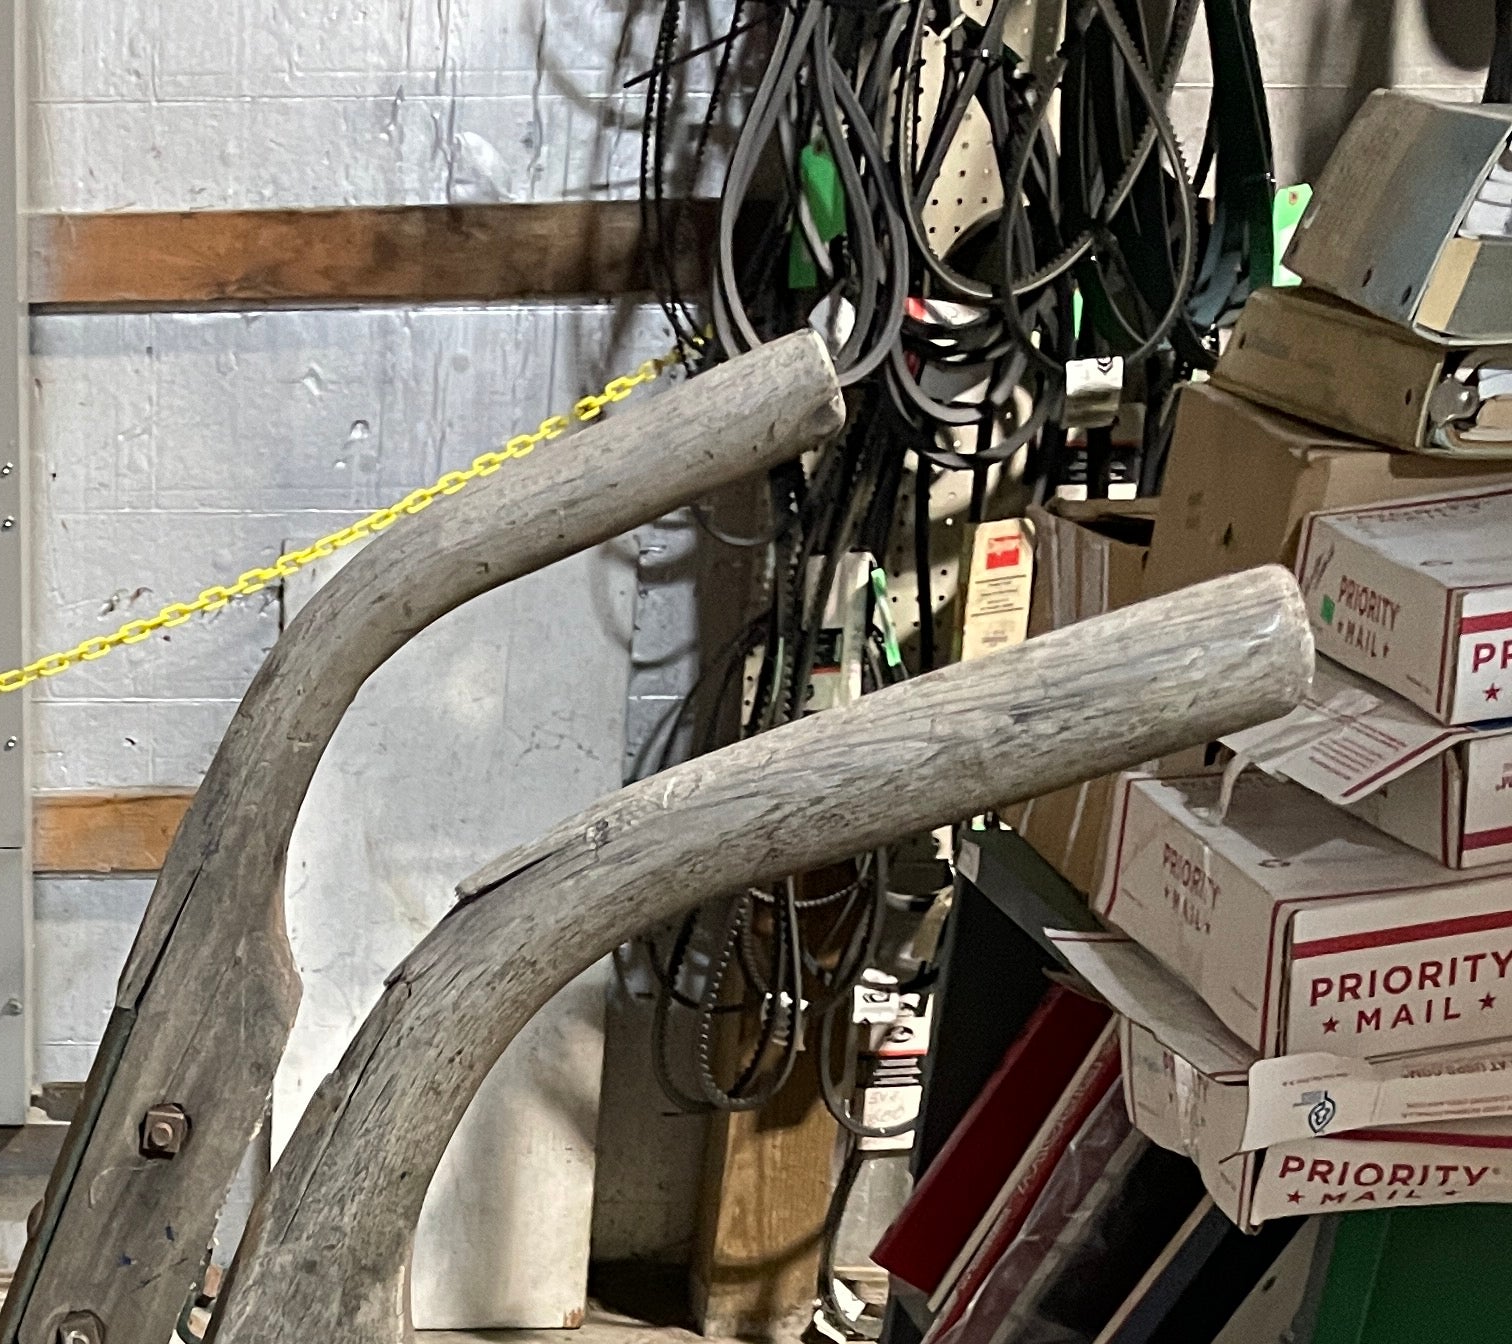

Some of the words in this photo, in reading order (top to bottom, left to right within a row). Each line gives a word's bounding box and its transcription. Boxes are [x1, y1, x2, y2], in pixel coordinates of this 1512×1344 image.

[1338, 574, 1400, 632] PRIORITY
[1344, 621, 1377, 658] MAIL
[1309, 950, 1512, 1007] PRIORITY
[1355, 996, 1461, 1034] MAIL
[1278, 1155, 1491, 1188] PRIORITY
